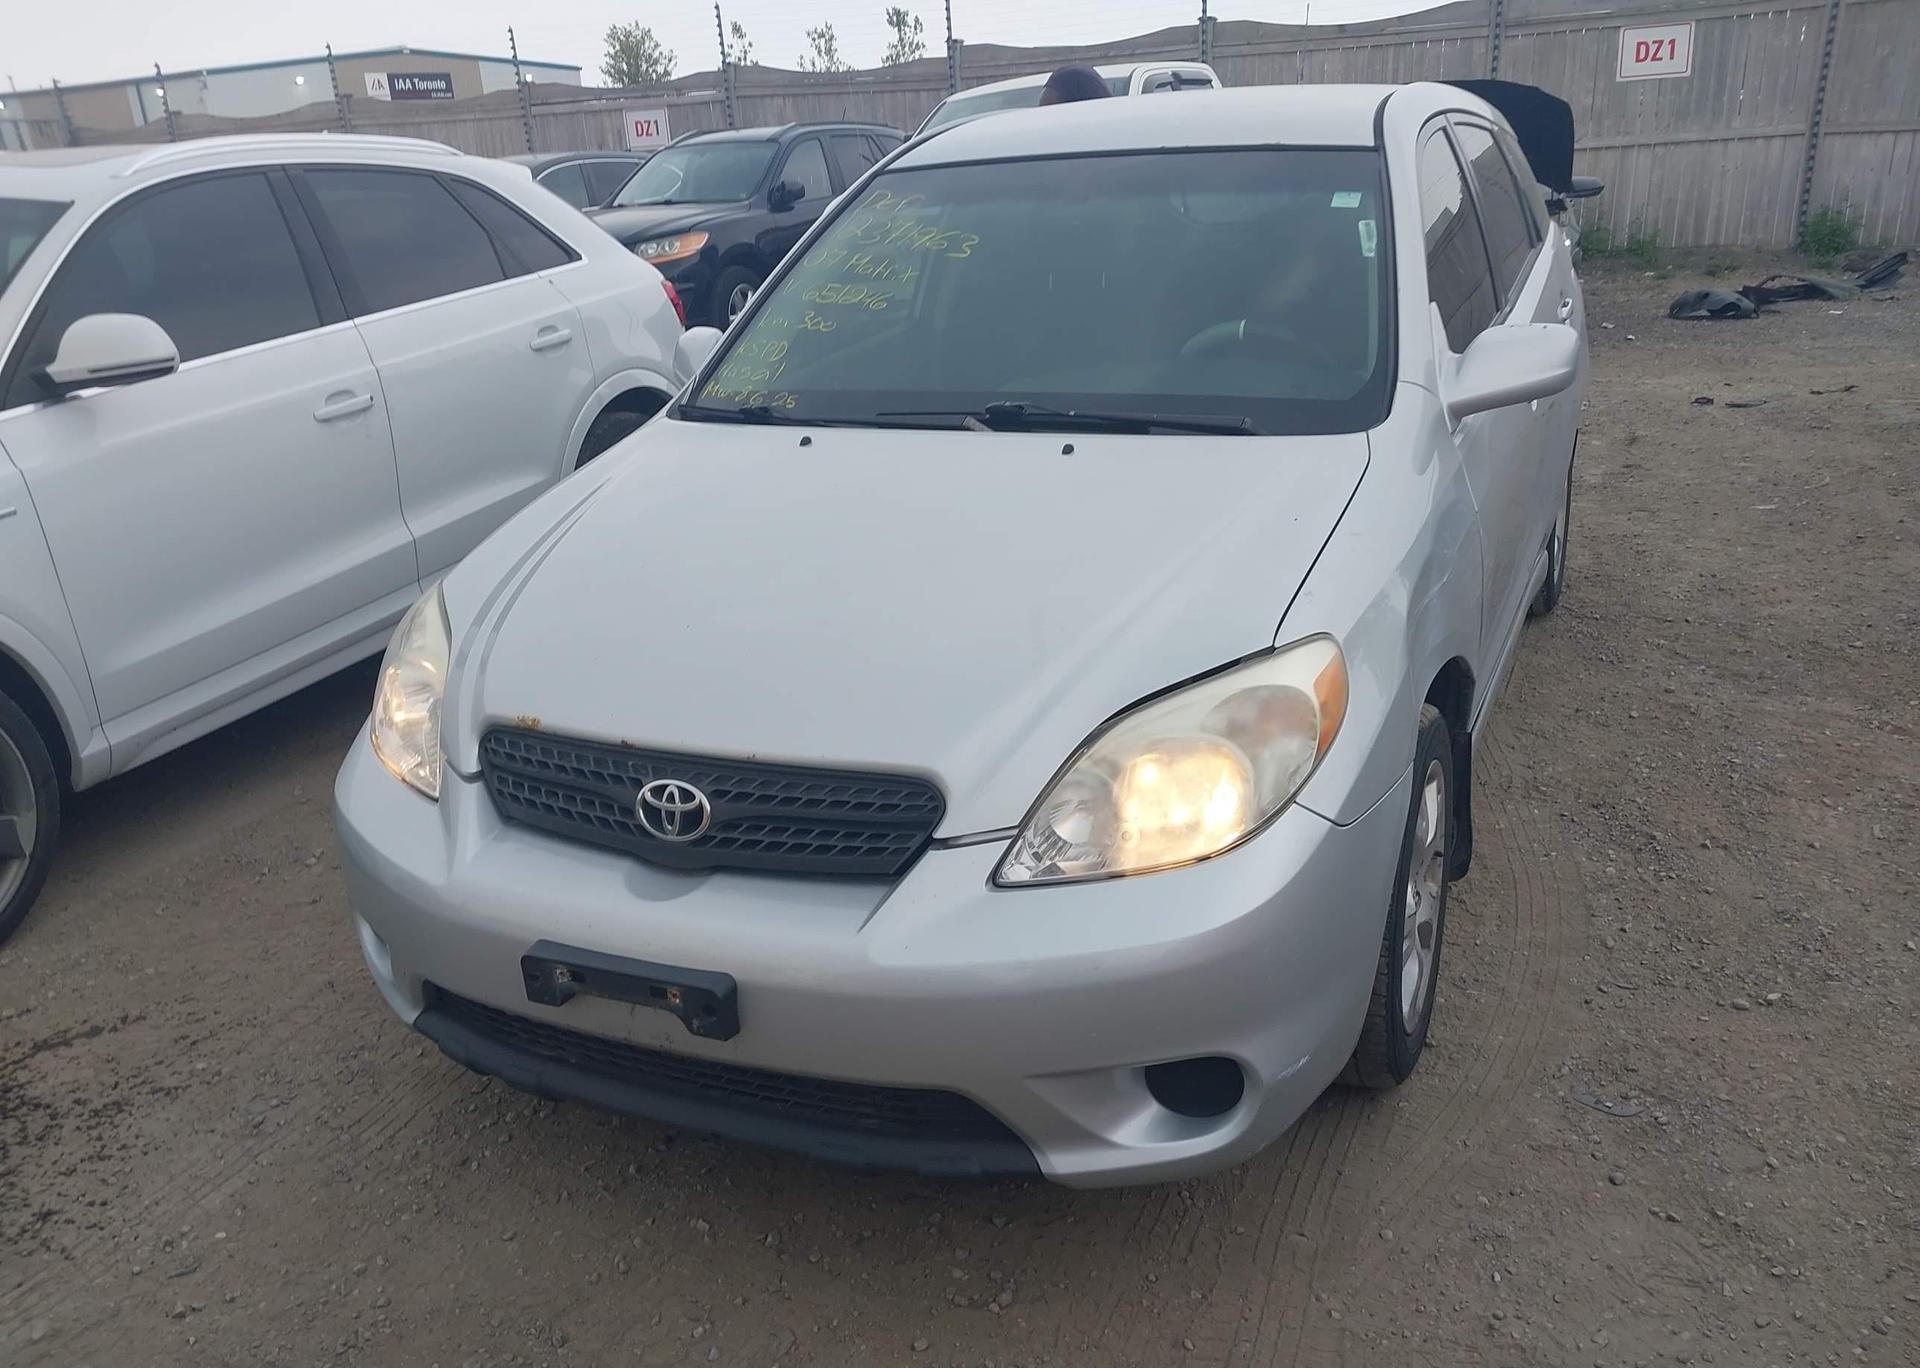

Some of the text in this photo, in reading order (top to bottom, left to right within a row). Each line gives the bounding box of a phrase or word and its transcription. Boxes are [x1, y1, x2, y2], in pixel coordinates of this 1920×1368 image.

[1633, 38, 1677, 63] DZ1
[394, 78, 447, 91] IAA Toronto
[634, 119, 660, 138] DZ1
